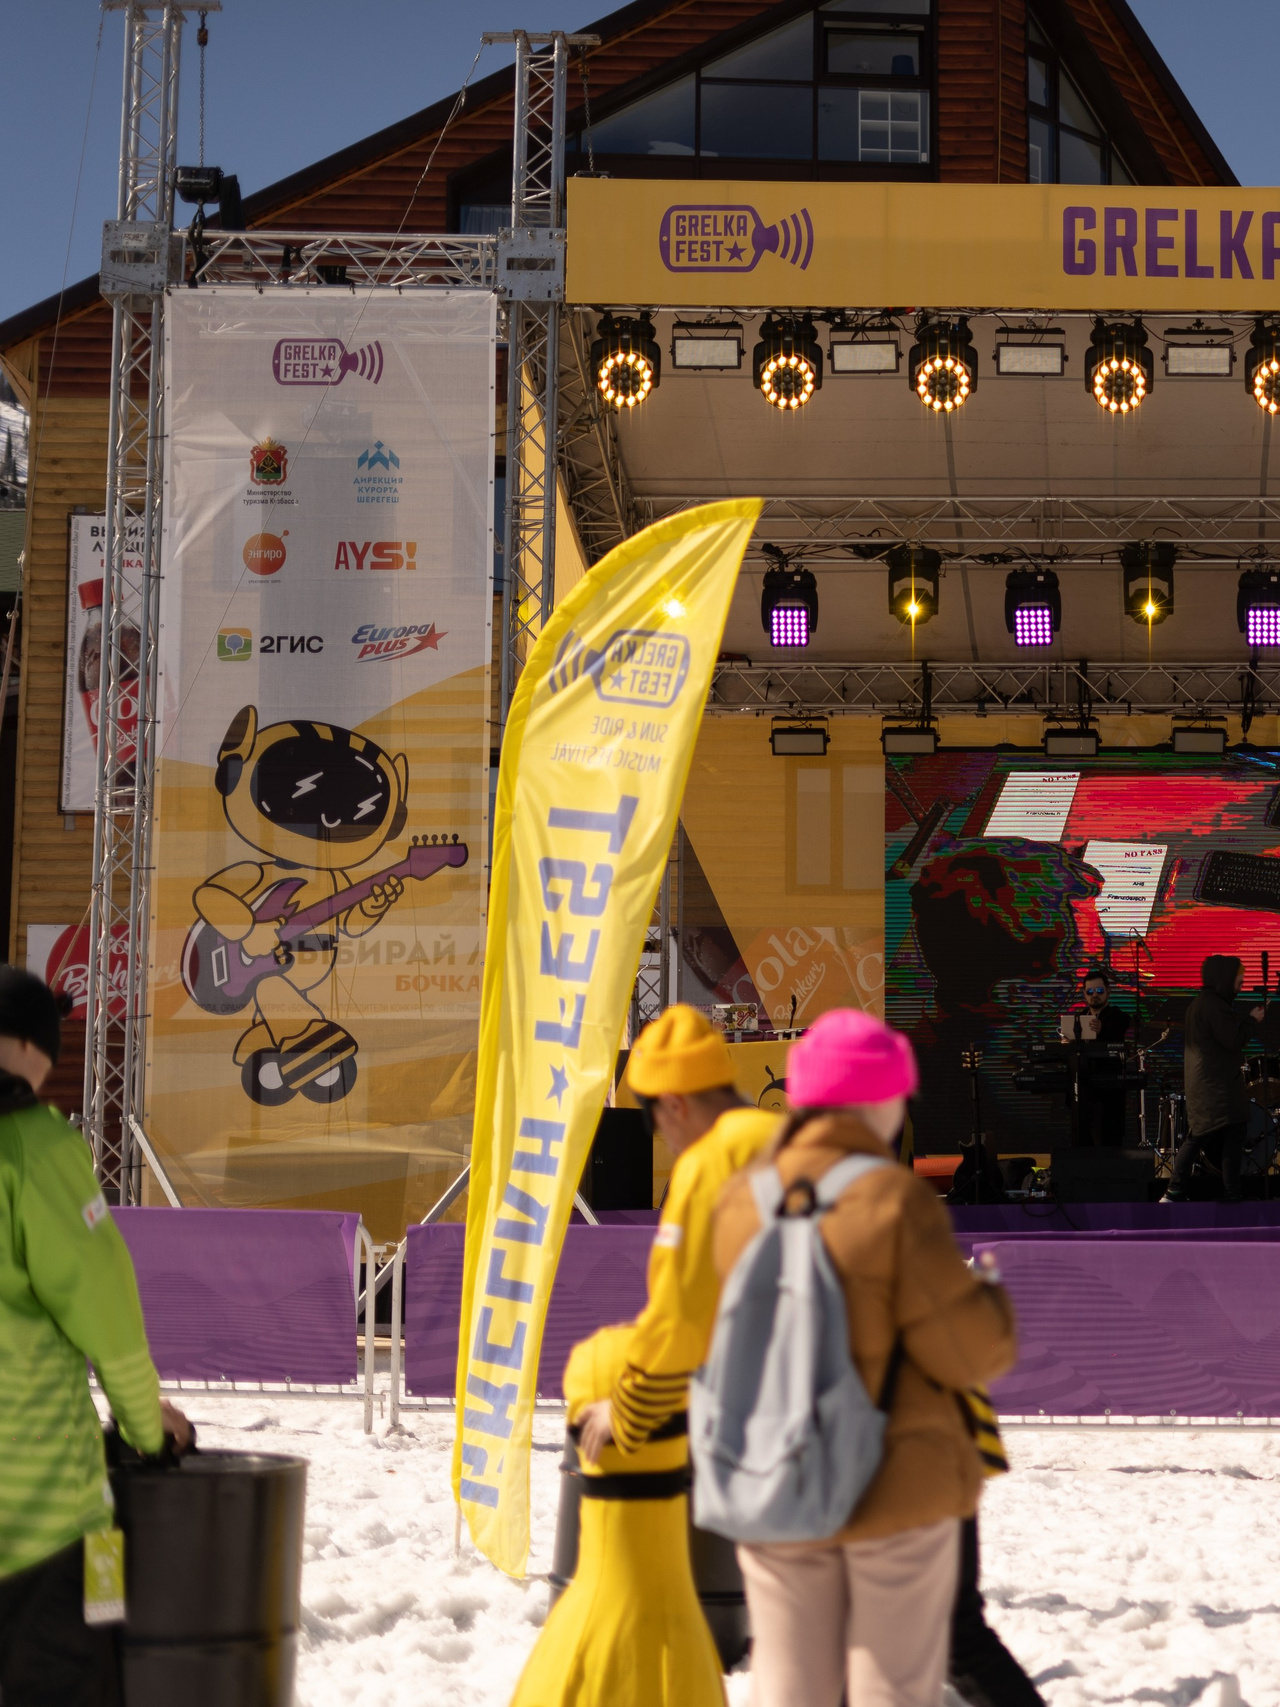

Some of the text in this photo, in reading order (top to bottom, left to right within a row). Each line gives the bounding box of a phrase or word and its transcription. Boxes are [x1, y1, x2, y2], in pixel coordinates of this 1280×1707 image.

[675, 214, 748, 237] GRELKA
[675, 240, 724, 262] FEST
[283, 344, 337, 361] GRELKA
[283, 362, 319, 379] FEST
[353, 477, 403, 485] ДИРЕКЦИЯ
[246, 489, 292, 499] Министерство
[357, 486, 398, 494] КУРОРТА
[243, 498, 268, 506] туризма
[247, 549, 283, 561] энгиро
[334, 541, 417, 571] AYS!
[259, 635, 324, 654] 2ГИС
[1124, 851, 1138, 859] NO
[273, 934, 452, 966] ВЫБИРАЙ
